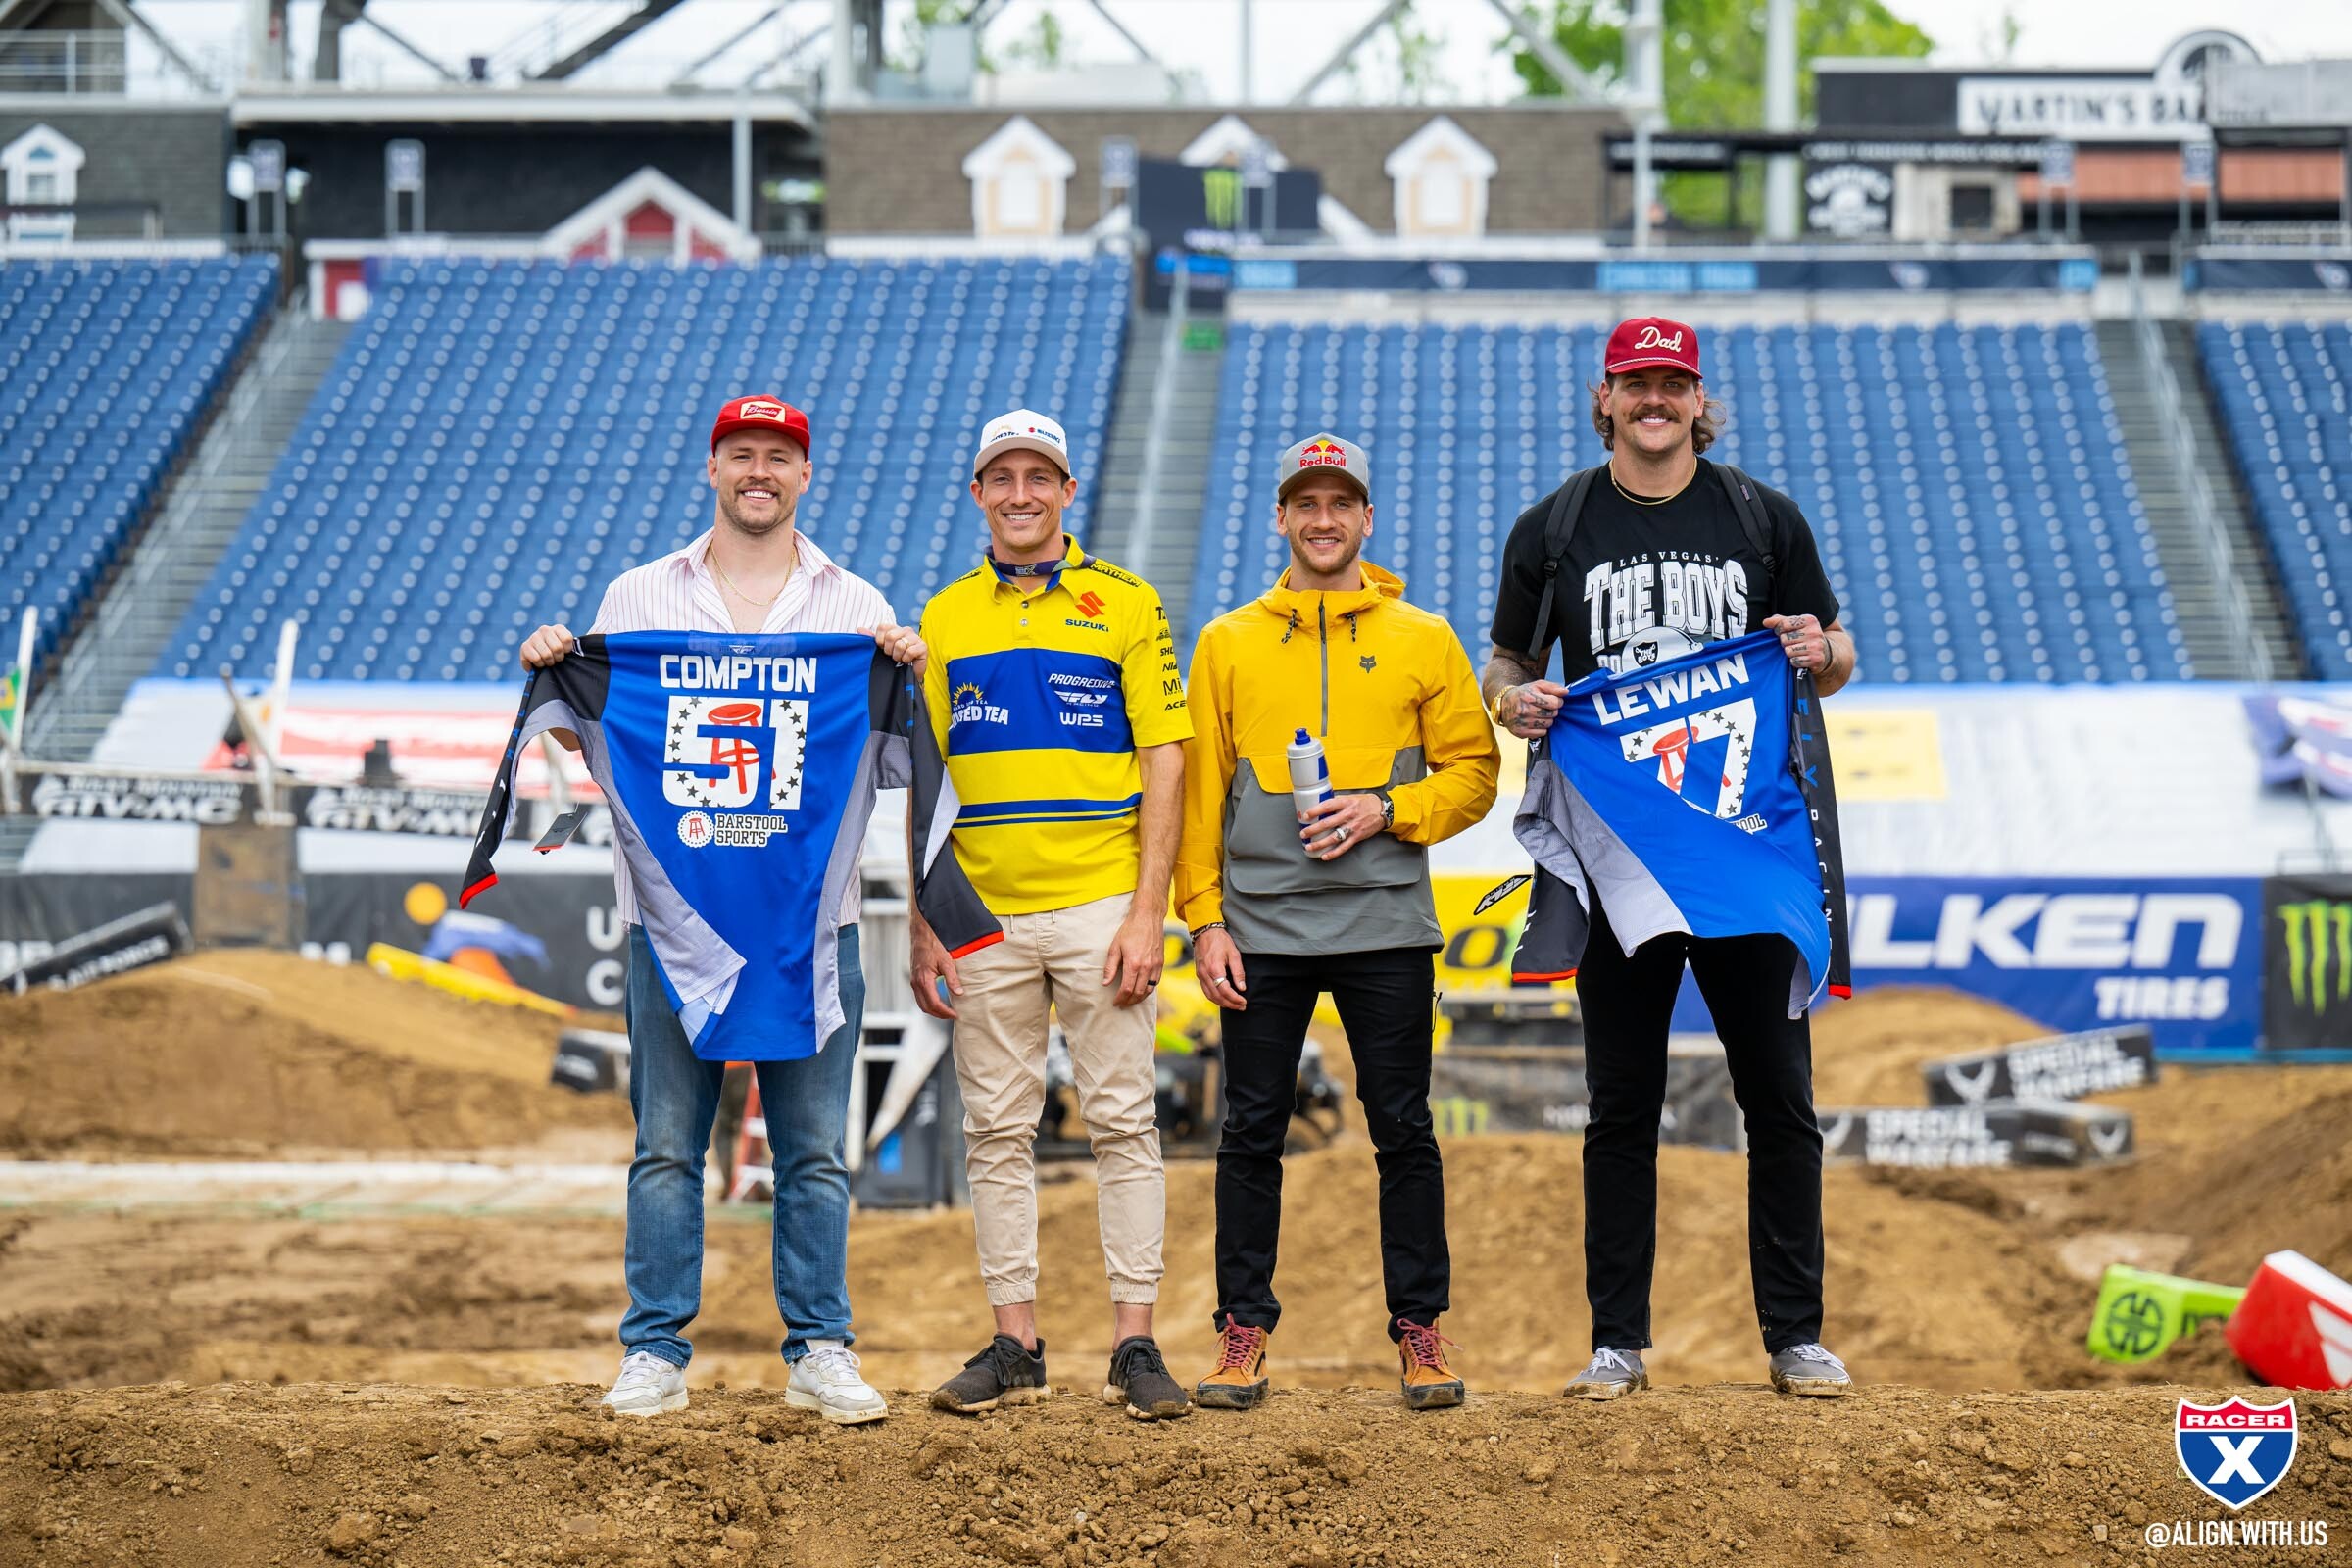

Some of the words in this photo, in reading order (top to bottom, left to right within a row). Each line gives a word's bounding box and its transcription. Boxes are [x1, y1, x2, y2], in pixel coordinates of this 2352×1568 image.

[1634, 326, 1683, 353] Dad
[1299, 455, 1322, 468] Red
[1324, 456, 1347, 467] Bull
[1619, 553, 1648, 567] LAS
[1090, 563, 1144, 588] MAYHEM
[1584, 562, 1655, 655] THE
[1661, 559, 1748, 640] BOYS
[1065, 618, 1109, 633] SUZUKI
[660, 655, 817, 693] COMPTON
[1054, 690, 1108, 704] FLY
[1592, 653, 1749, 725] LEWAN
[985, 705, 1009, 726] TEA
[1059, 712, 1104, 727] WPS
[662, 695, 809, 810] 51
[1619, 697, 1757, 819] 77
[716, 814, 786, 831] BARSTOOL
[716, 831, 766, 845] SPORTS
[2095, 977, 2230, 1020] TIRES
